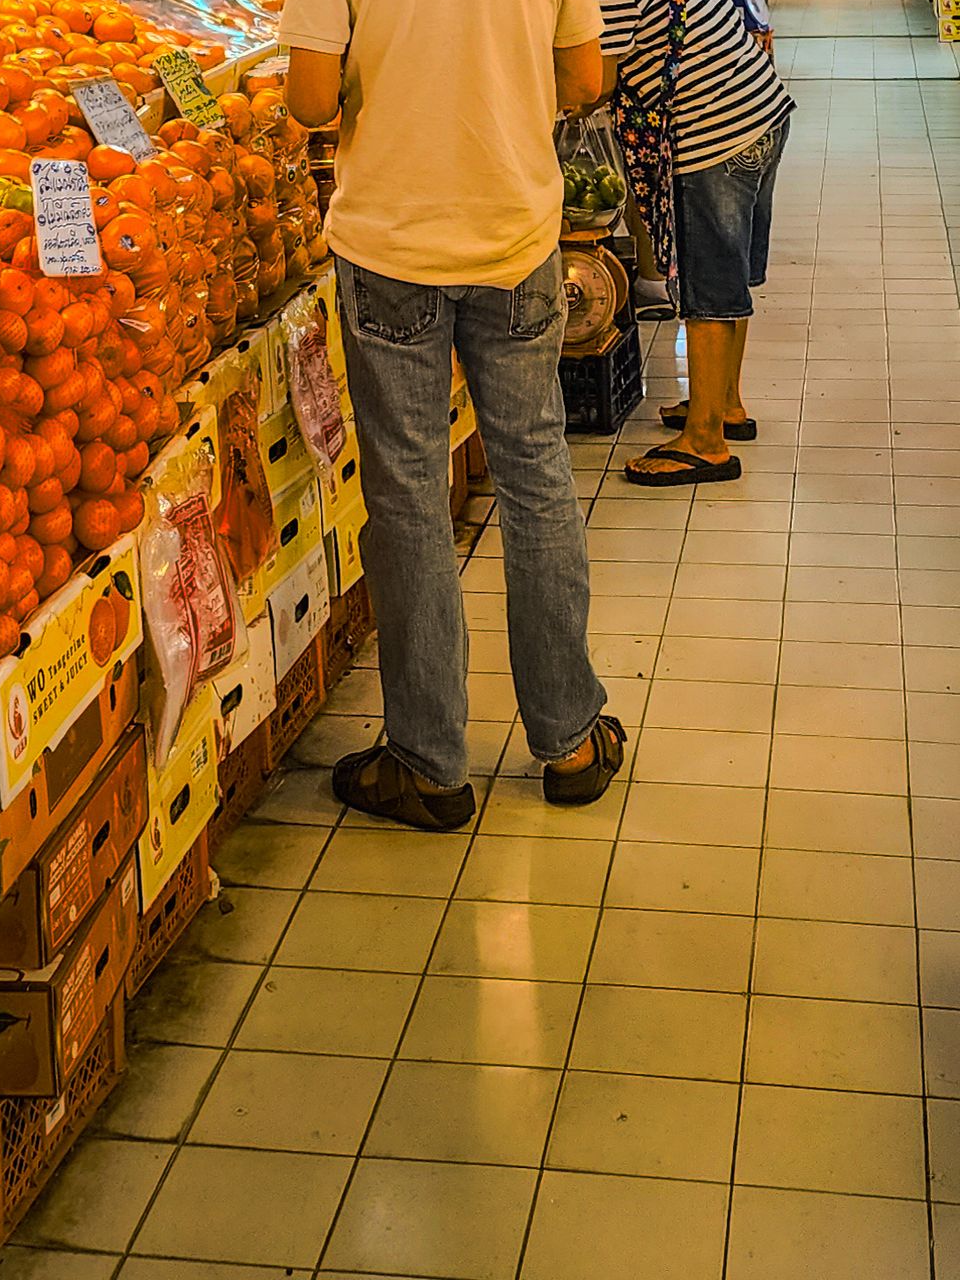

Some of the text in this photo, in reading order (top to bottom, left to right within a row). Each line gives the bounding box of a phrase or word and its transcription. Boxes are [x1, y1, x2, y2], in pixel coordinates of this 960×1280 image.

[26, 634, 86, 704] WO Tangerine
[33, 685, 60, 726] SWEET
[65, 652, 89, 687] JUICY
